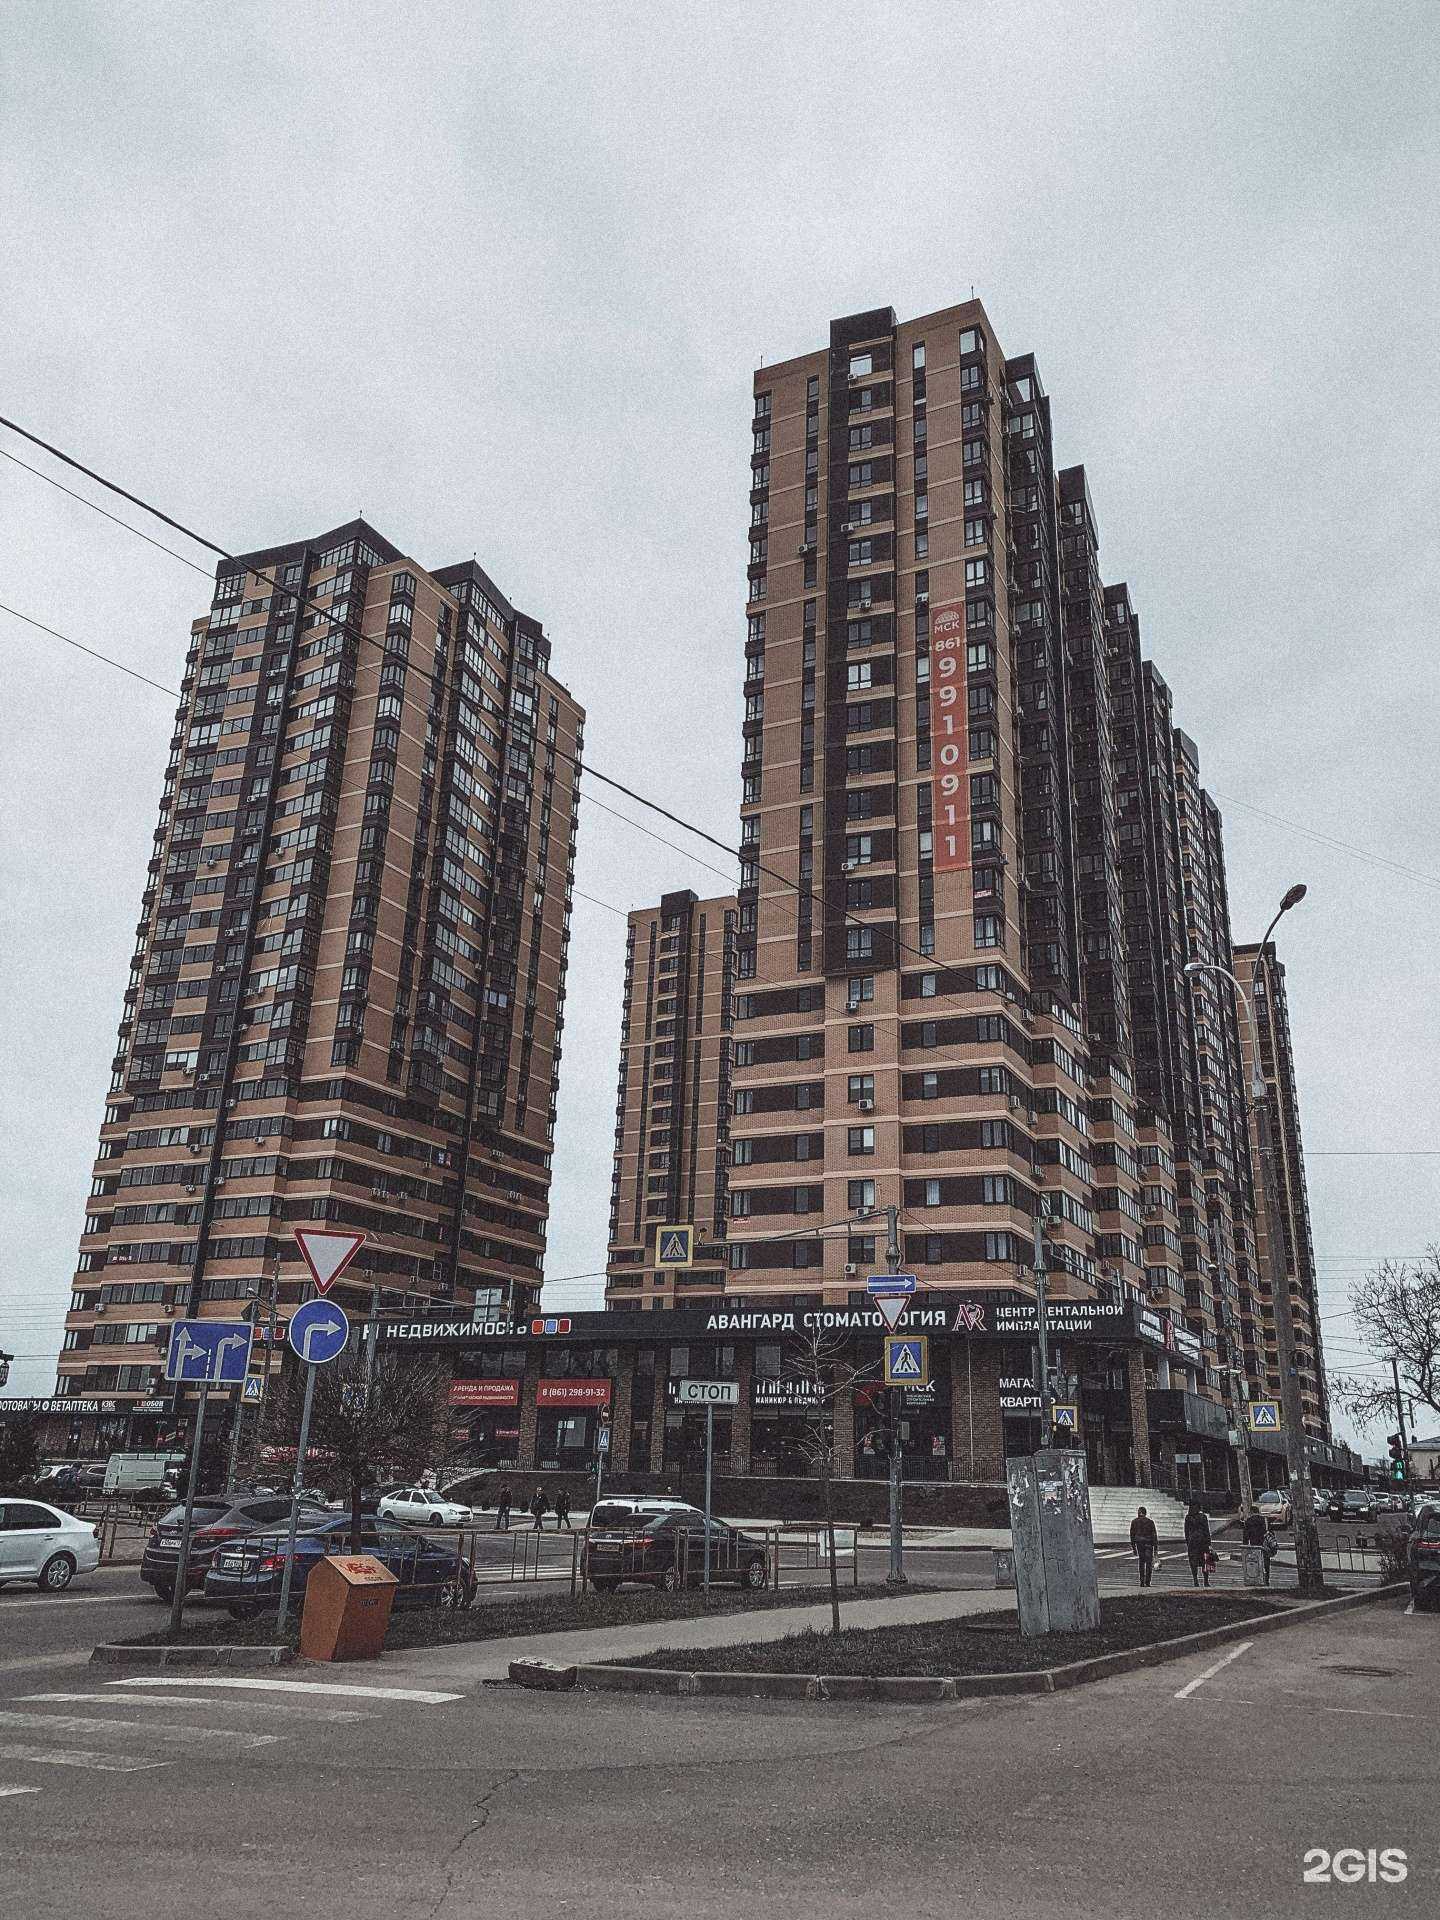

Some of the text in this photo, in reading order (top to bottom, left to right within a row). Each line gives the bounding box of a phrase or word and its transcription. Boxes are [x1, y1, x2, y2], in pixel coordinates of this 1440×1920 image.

[935, 620, 959, 633] МСК
[936, 637, 960, 651] 861
[996, 1305, 1123, 1318] ЦЕНТР ЕНТАЛЬНОЙ
[706, 1311, 946, 1330] АВАНГАРД СТОМАТООГИЯ
[997, 1320, 1092, 1331] ИМПЛАТАЦИИ
[550, 1388, 567, 1398] (861)
[569, 1388, 605, 1397] 298-91-32
[687, 1384, 731, 1400] СТОП
[51, 1401, 98, 1411] ВЕТАПТЕКА
[755, 1396, 786, 1404] МАНИКЮР
